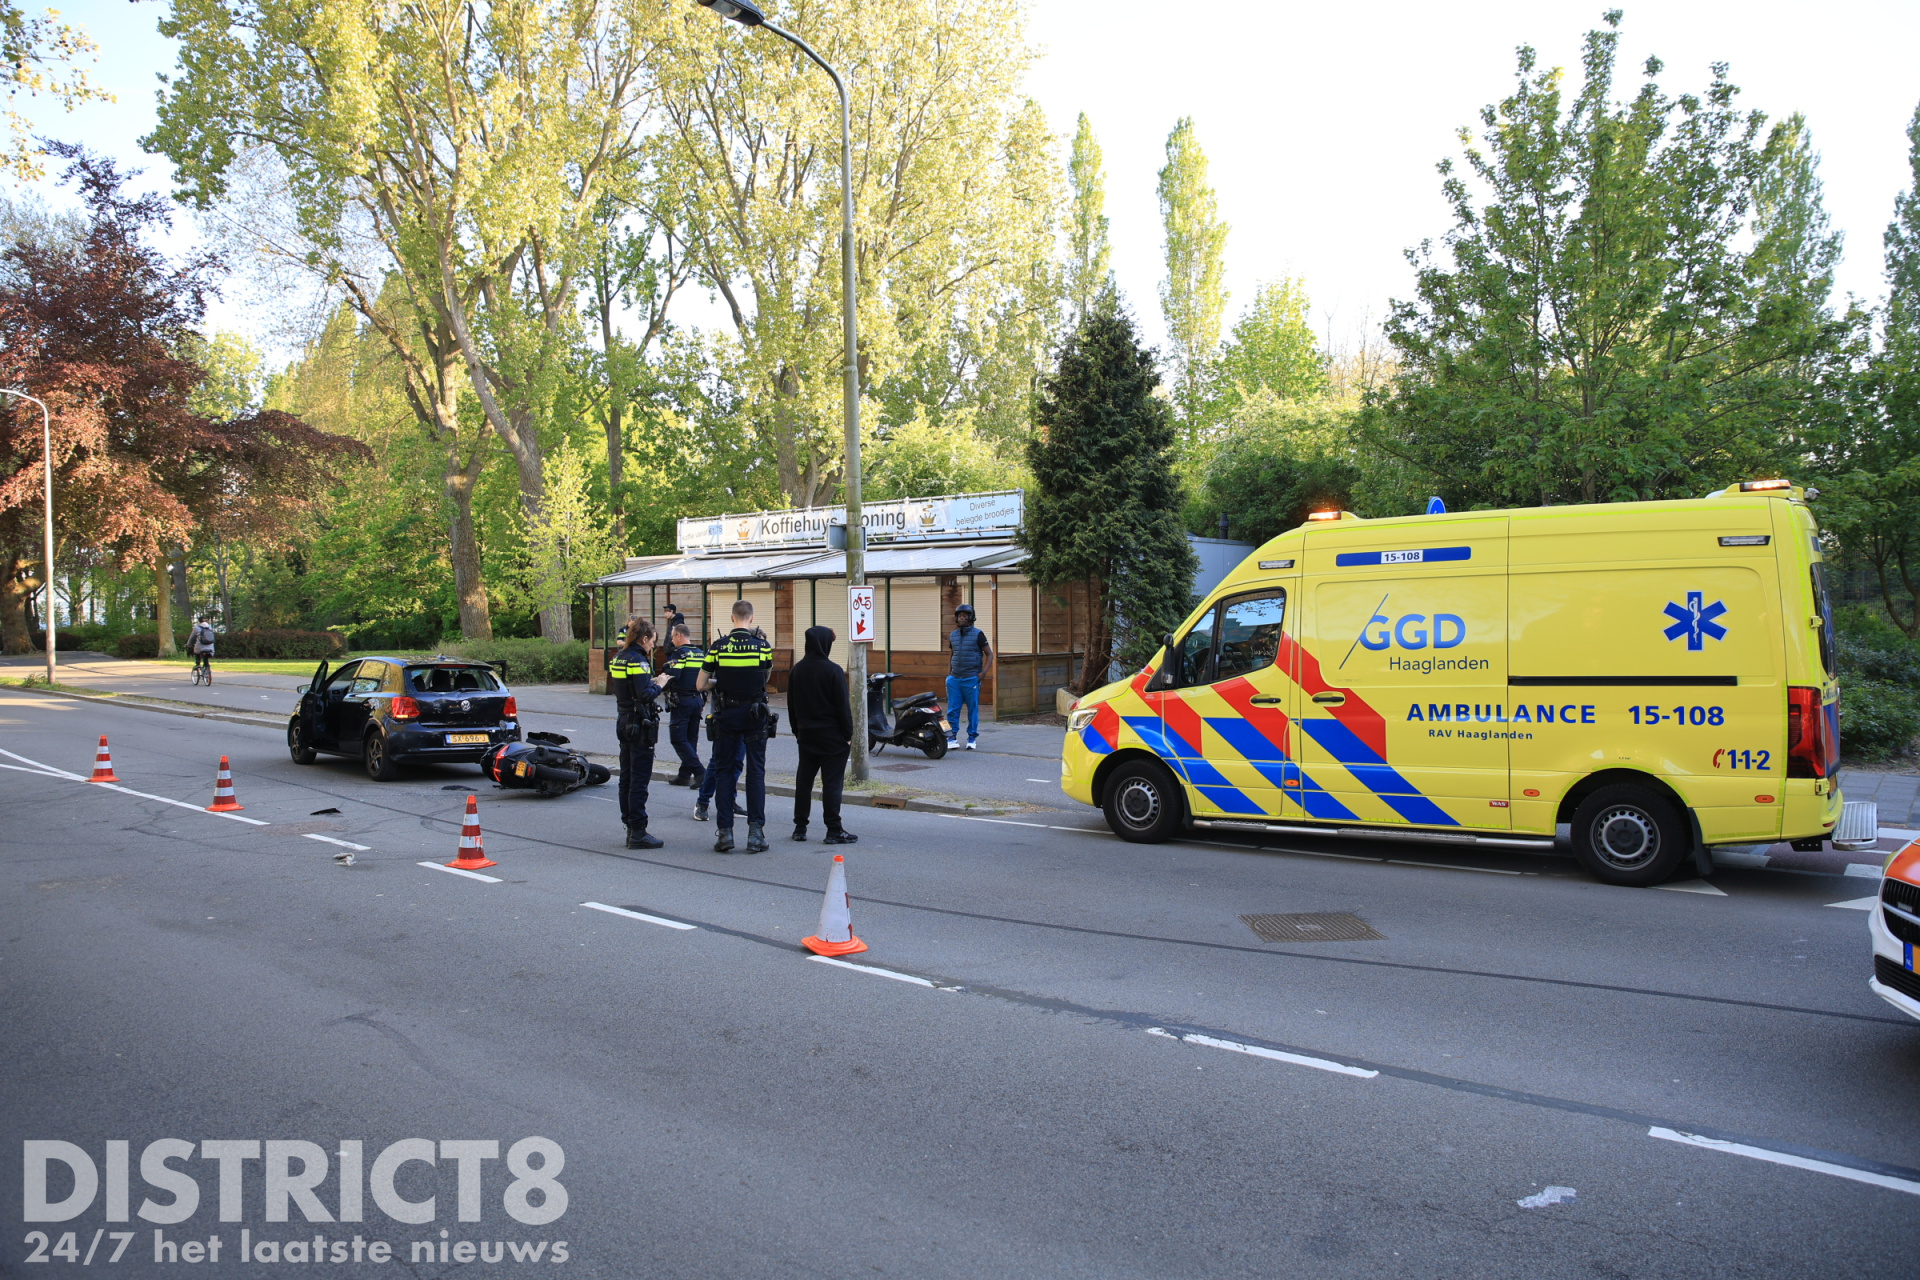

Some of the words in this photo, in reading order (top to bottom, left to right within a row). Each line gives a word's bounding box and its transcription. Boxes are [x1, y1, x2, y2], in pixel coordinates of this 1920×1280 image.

[969, 499, 996, 511] Diverse
[860, 509, 906, 530] oning
[956, 514, 983, 526] belegde
[984, 507, 1015, 519] broodjes
[1384, 551, 1420, 562] 15-108
[1359, 613, 1466, 651] GGD
[1389, 656, 1489, 674] Haaglanden
[1406, 703, 1596, 724] AMBULANCE
[1628, 705, 1725, 726] 15-108
[1428, 729, 1453, 738] RAV
[1457, 729, 1533, 740] Haaglanden
[1727, 749, 1771, 770] 1-1-2
